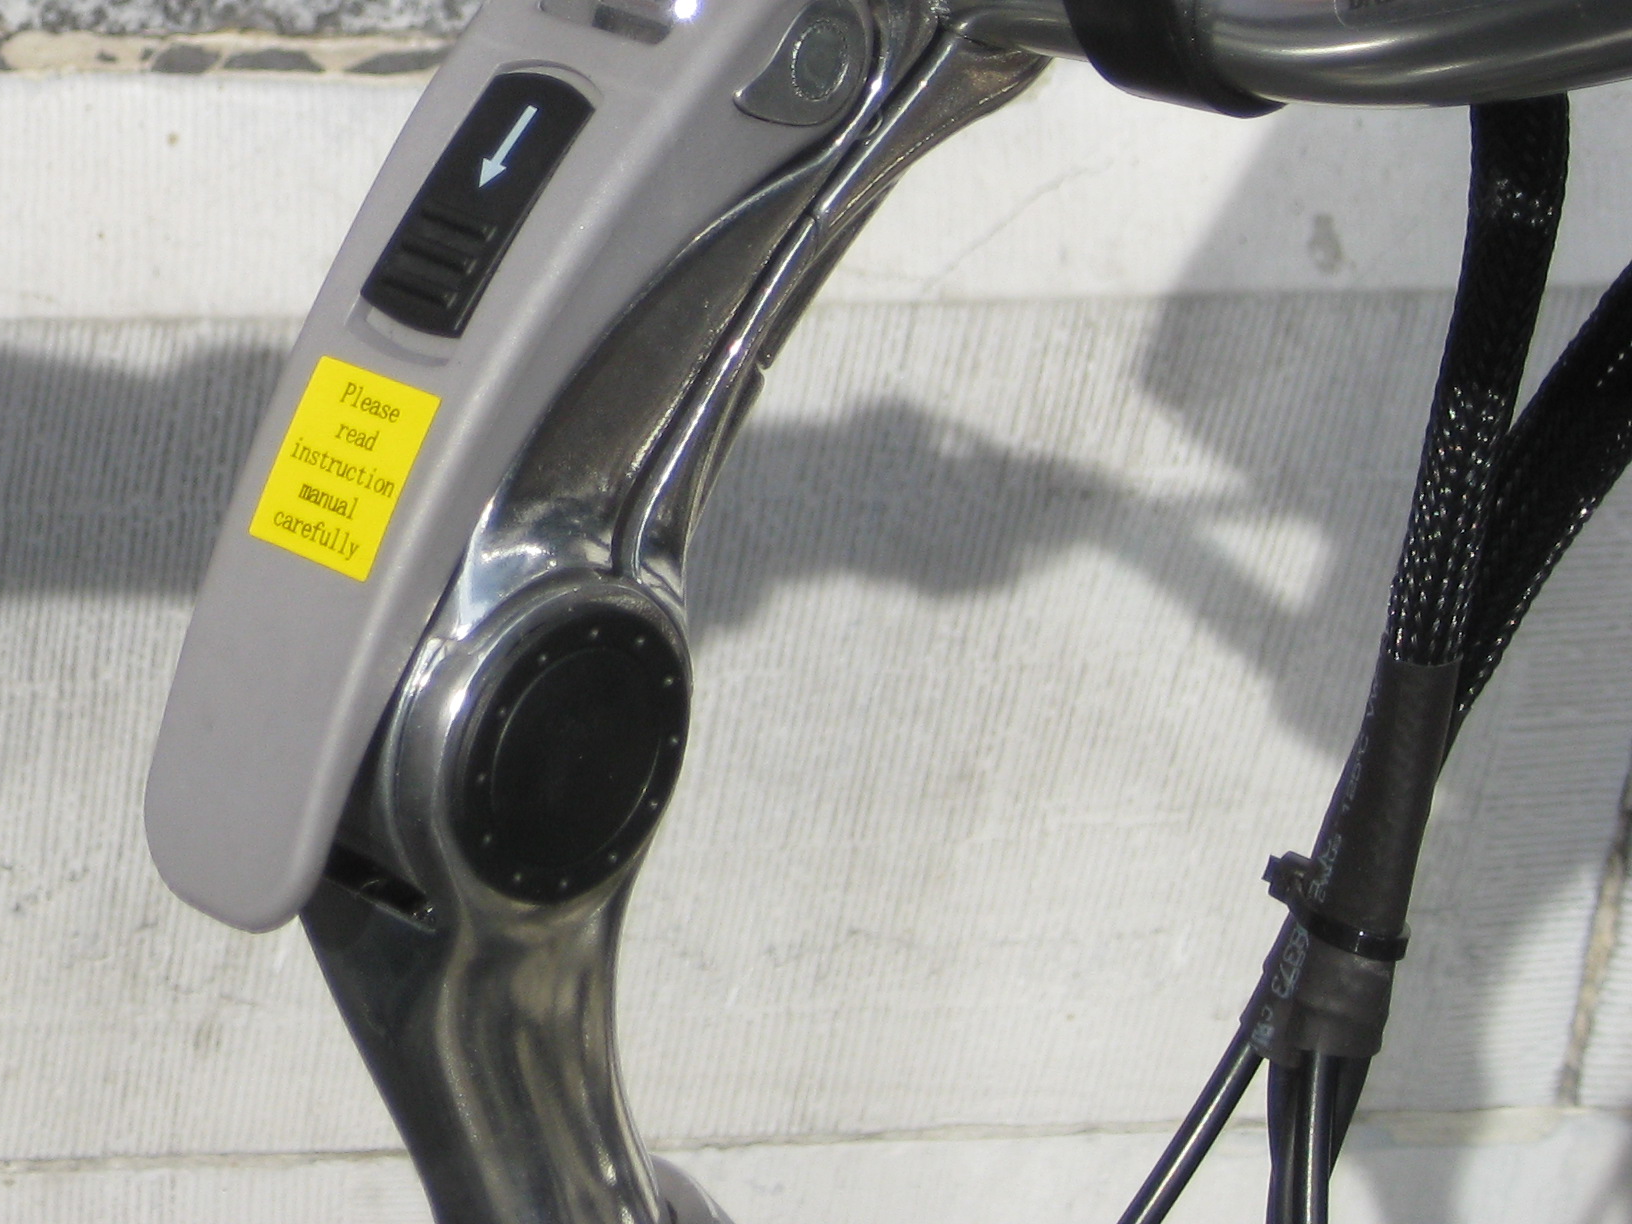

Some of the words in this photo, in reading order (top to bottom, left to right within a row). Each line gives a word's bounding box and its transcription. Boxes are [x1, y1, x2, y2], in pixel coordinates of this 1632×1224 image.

[339, 382, 400, 423] Please
[335, 423, 380, 452] read
[290, 437, 395, 498] instruction
[298, 483, 358, 520] manual
[273, 511, 360, 561] carefully
